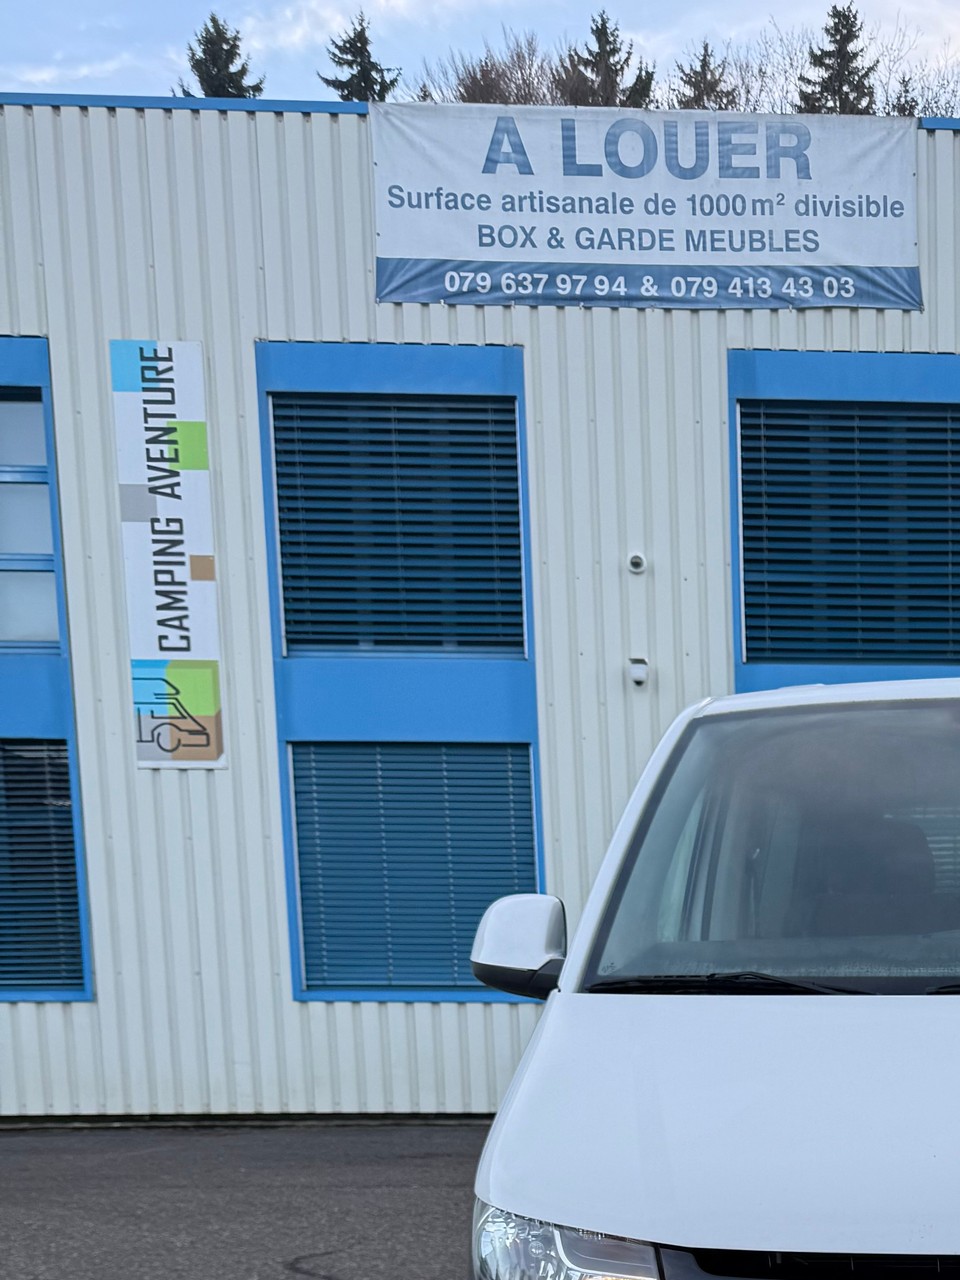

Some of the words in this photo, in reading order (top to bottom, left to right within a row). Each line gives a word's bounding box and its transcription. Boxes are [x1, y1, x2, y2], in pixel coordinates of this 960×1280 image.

[481, 116, 535, 176] A
[561, 117, 813, 180] LOUER
[387, 184, 492, 211] Surface
[501, 188, 635, 216] artisanale
[644, 191, 677, 217] de
[794, 193, 905, 219] divisible
[477, 224, 538, 250] BOX
[546, 226, 566, 250] &
[574, 226, 676, 252] GARDE
[685, 228, 821, 253] MEUBLES
[444, 270, 491, 294] 079
[500, 271, 548, 295] 637
[555, 273, 588, 296] 97
[593, 274, 628, 297] 94
[640, 274, 660, 297] &
[670, 275, 718, 299] 079
[727, 275, 773, 299] 413
[781, 275, 815, 299] 43
[822, 275, 856, 299] 03
[139, 346, 182, 500] AVENTURE
[150, 517, 192, 652] CAMPING
